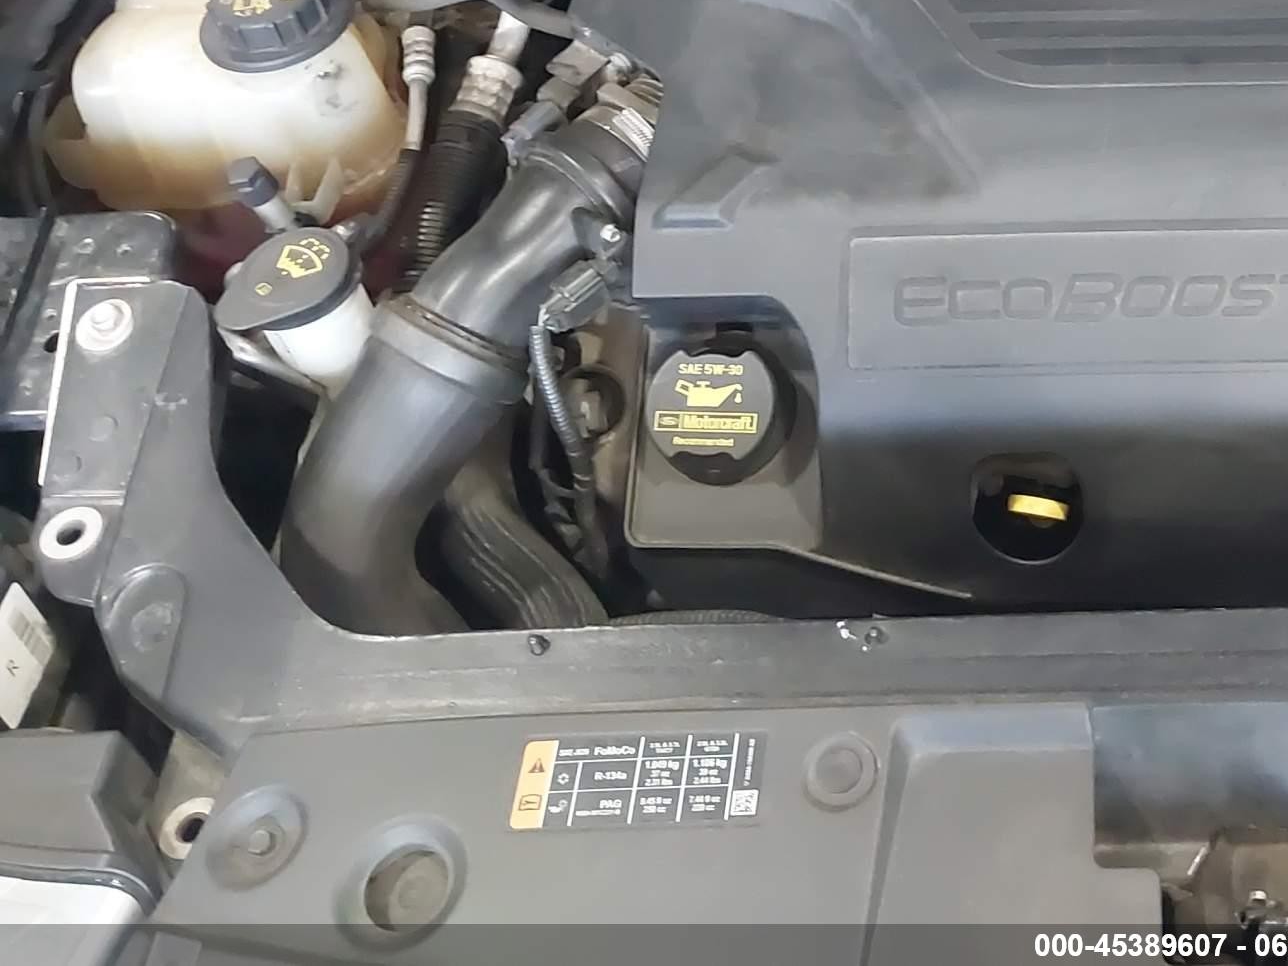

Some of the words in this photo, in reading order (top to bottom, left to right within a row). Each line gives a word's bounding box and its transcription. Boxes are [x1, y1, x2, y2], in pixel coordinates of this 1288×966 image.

[678, 363, 703, 375] SAE
[704, 363, 744, 376] 5W-30
[684, 415, 755, 431] Motorcraft
[593, 745, 637, 756] FoMoCo
[600, 799, 622, 809] PAG
